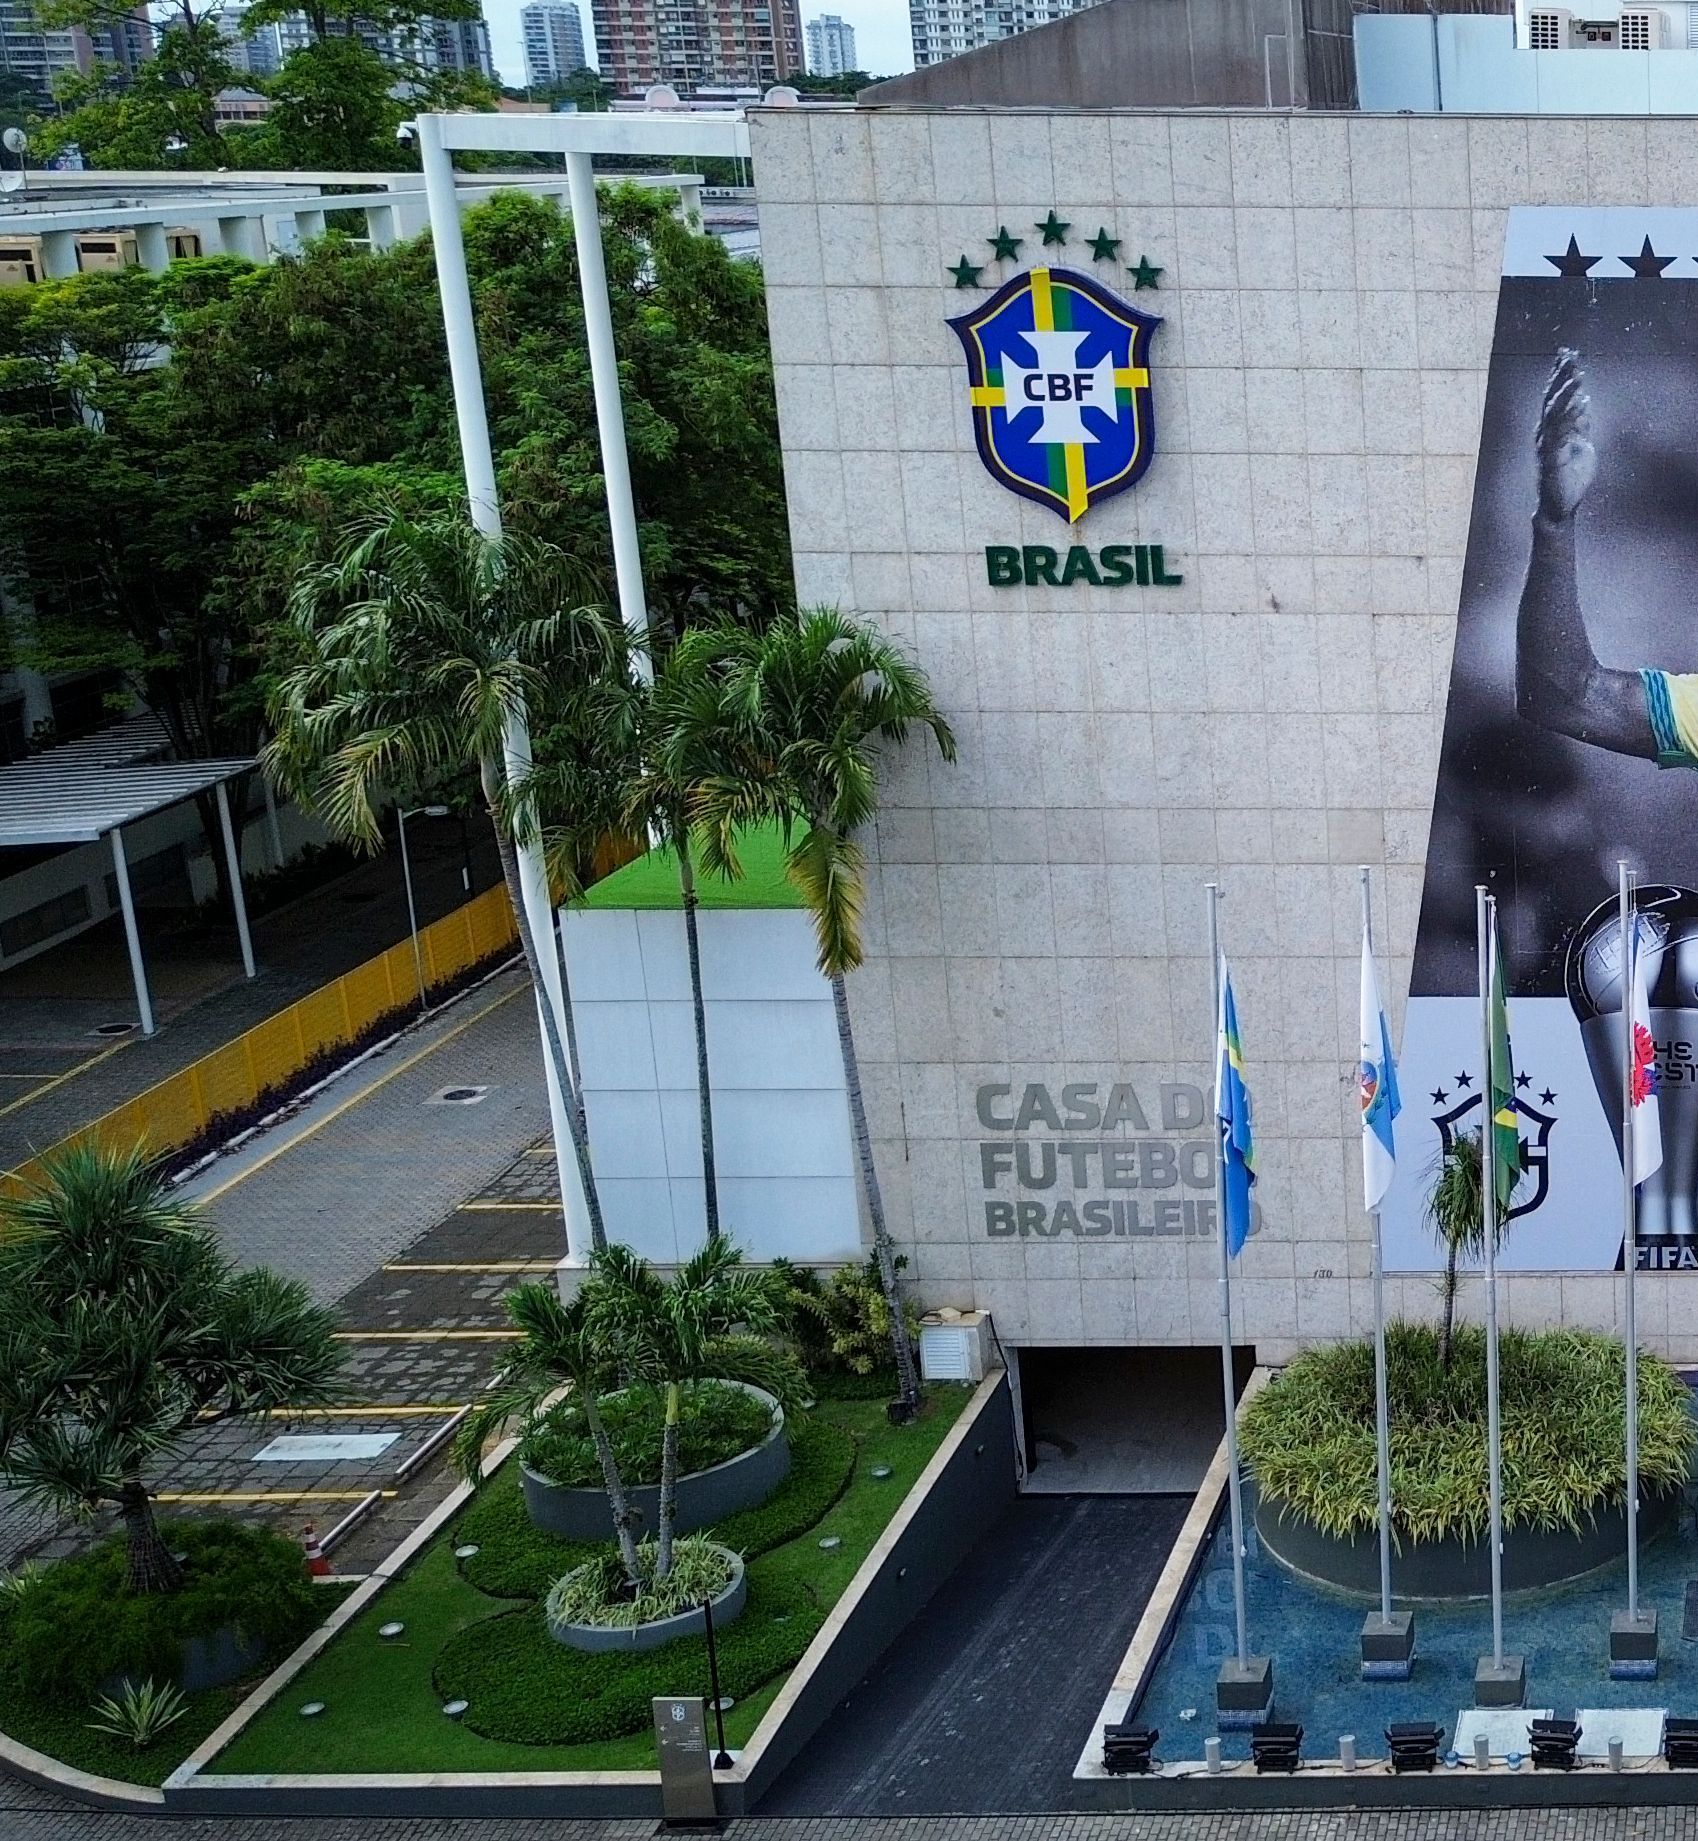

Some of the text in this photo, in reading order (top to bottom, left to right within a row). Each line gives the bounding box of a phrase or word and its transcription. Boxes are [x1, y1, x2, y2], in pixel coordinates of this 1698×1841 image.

[1023, 373, 1094, 401] CBF
[985, 544, 1184, 587] BRASIL
[1652, 1041, 1693, 1060] HE
[976, 1082, 1149, 1130] CASA
[979, 1141, 1258, 1189] FUTEBO
